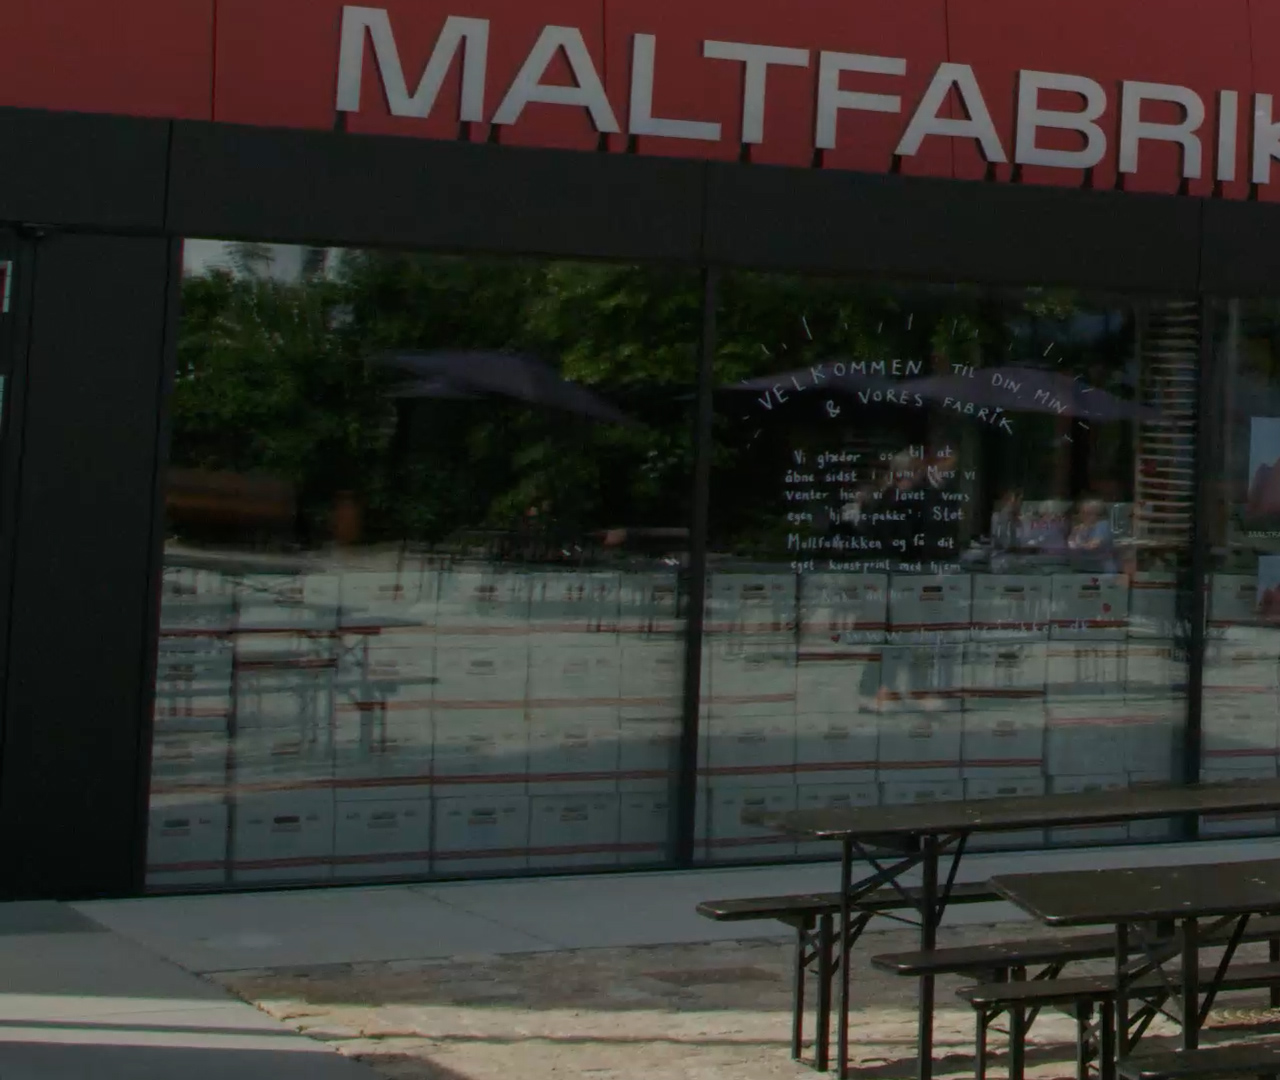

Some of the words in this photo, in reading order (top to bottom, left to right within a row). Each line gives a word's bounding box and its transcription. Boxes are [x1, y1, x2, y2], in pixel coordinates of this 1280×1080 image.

[758, 359, 922, 410] VELKOMMEN
[1034, 389, 1067, 414] MIN
[826, 400, 841, 418] &
[858, 388, 923, 407] VORES
[943, 397, 1014, 435] FABRIK
[909, 445, 924, 460] til
[937, 445, 953, 458] at
[825, 470, 857, 482] sidst
[896, 487, 925, 502] lavet
[892, 539, 907, 552] og
